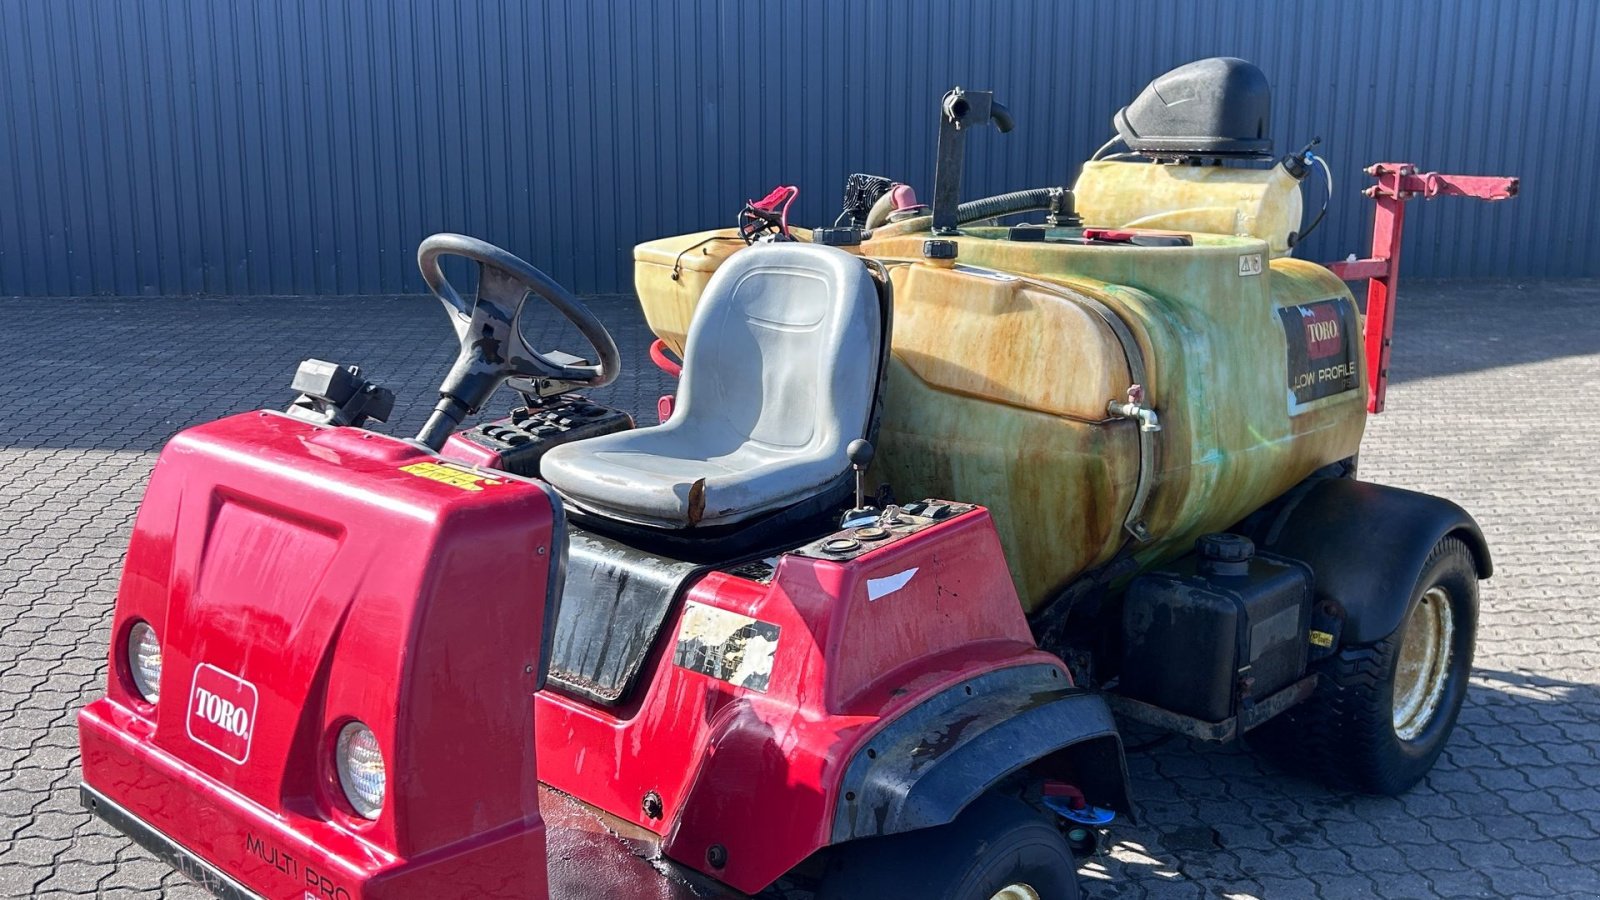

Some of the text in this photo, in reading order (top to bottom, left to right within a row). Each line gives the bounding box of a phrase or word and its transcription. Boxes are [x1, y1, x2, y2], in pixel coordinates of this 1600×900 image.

[1308, 320, 1337, 343] TORO
[1295, 362, 1355, 389] LOW PROFILE
[195, 687, 248, 737] TORO
[246, 832, 352, 900] MULTI PRO
